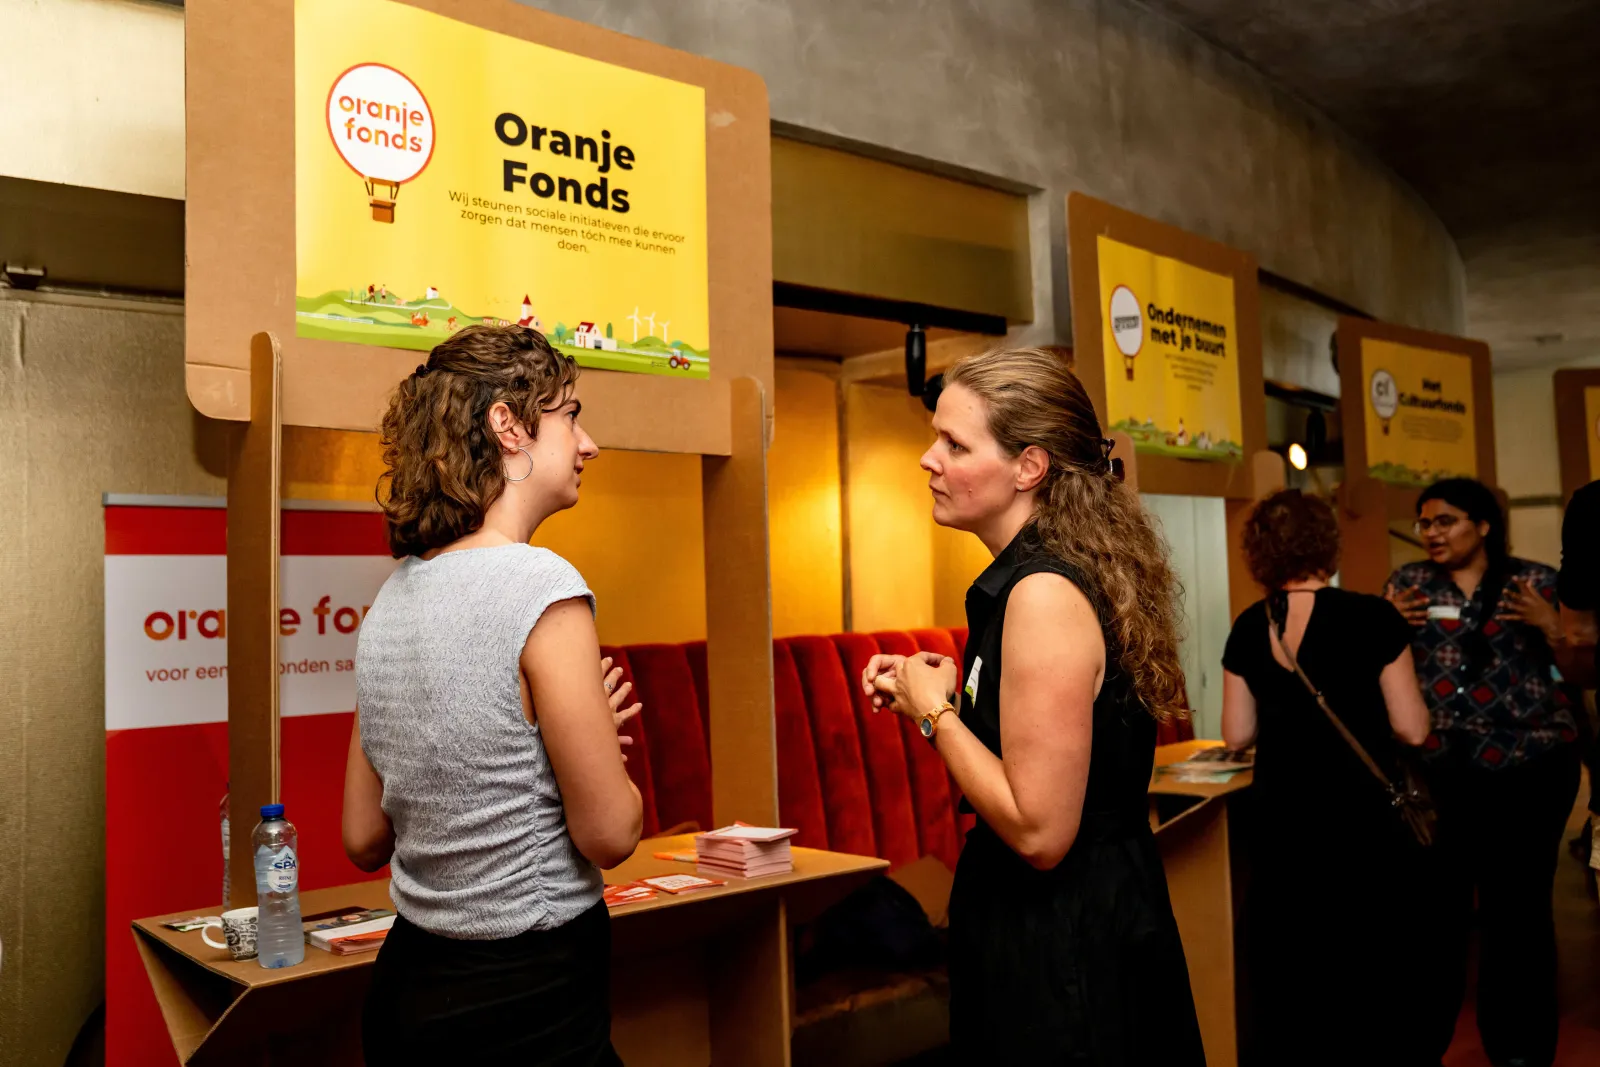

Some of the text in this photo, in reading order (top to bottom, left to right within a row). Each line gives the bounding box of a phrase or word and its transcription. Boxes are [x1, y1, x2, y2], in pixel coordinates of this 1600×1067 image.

[338, 95, 424, 134] oranje
[344, 117, 422, 153] fonds
[494, 112, 635, 174] Oranje
[503, 159, 630, 214] Fonds
[448, 189, 685, 243] Wij steunen sociale initiatieven die ervoor
[460, 209, 676, 255] zorgen dat mensen tóch mee kunnen
[557, 239, 589, 254] doen.
[1147, 302, 1226, 339] Ondernemen
[1151, 326, 1225, 359] met je buurt
[144, 608, 301, 641] orae
[145, 667, 190, 683] voor
[274, 859, 297, 870] SPA
